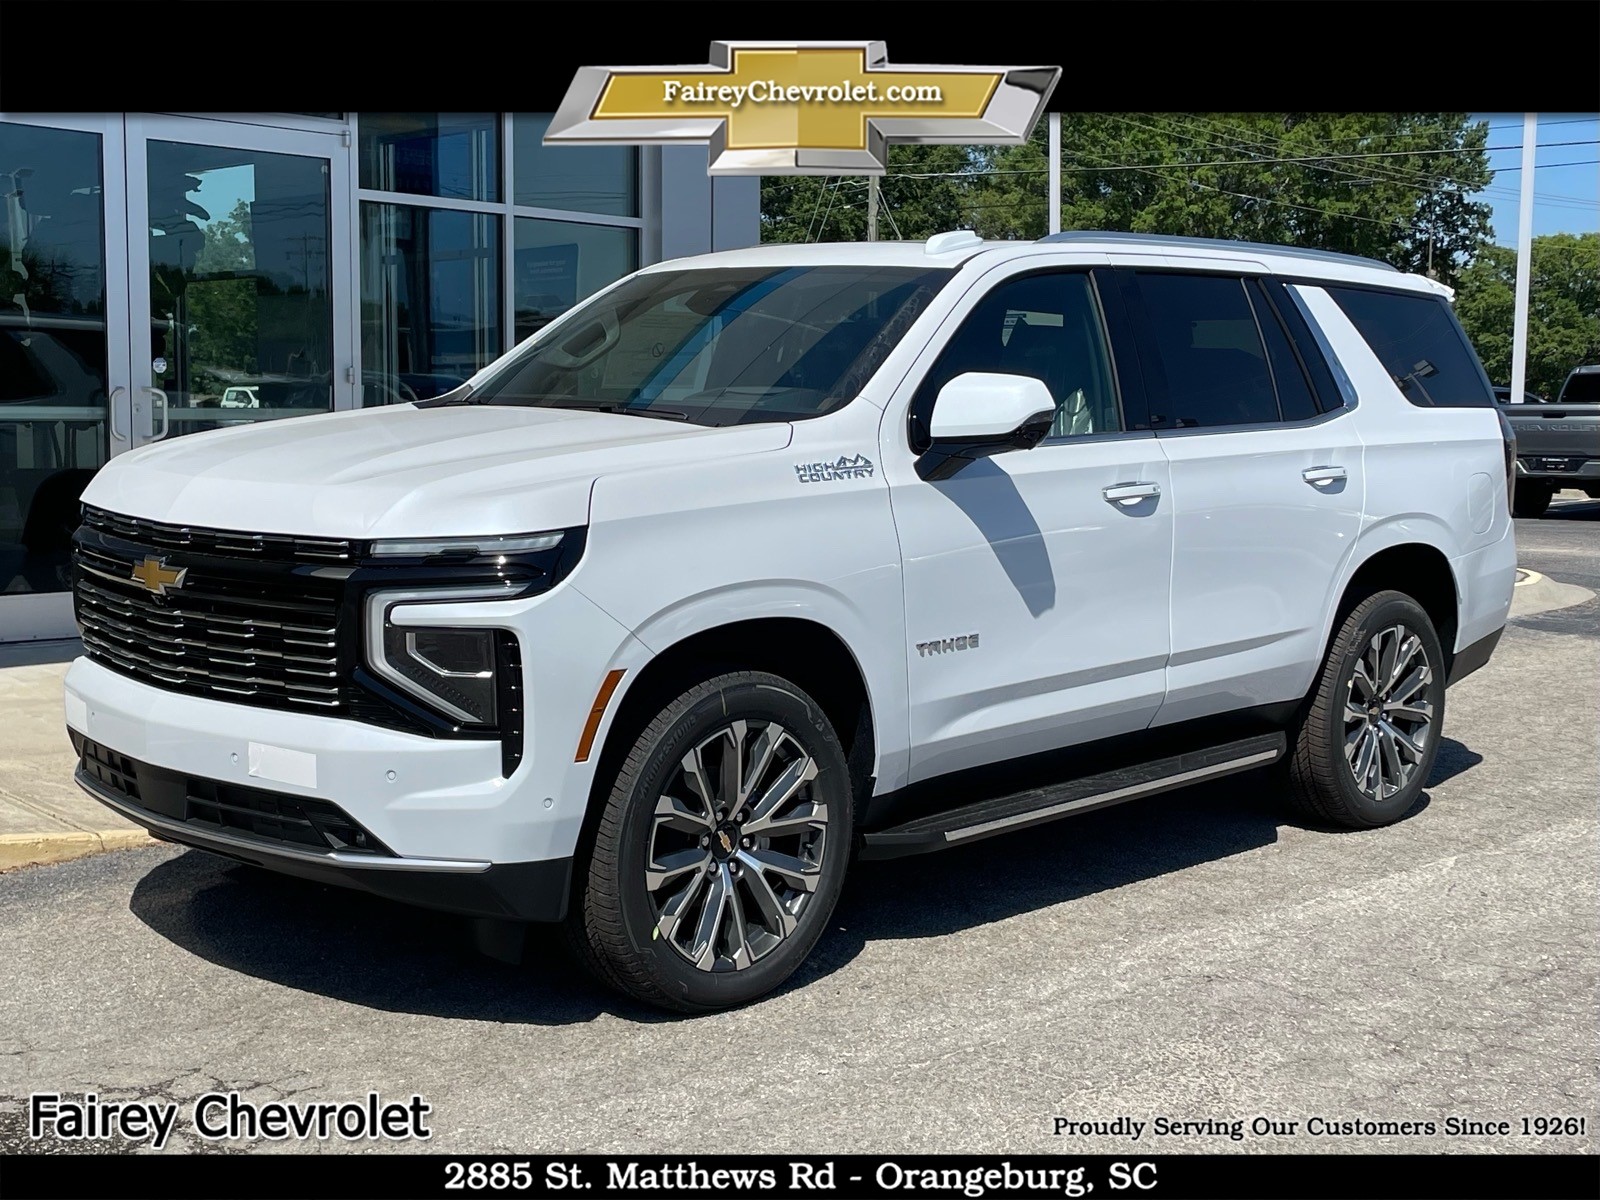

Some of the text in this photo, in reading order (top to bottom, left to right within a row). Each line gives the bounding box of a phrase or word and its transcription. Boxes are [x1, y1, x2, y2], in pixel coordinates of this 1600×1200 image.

[794, 462, 837, 473] HIGH
[799, 468, 874, 483] COUNTRY
[916, 633, 980, 658] TAHOE
